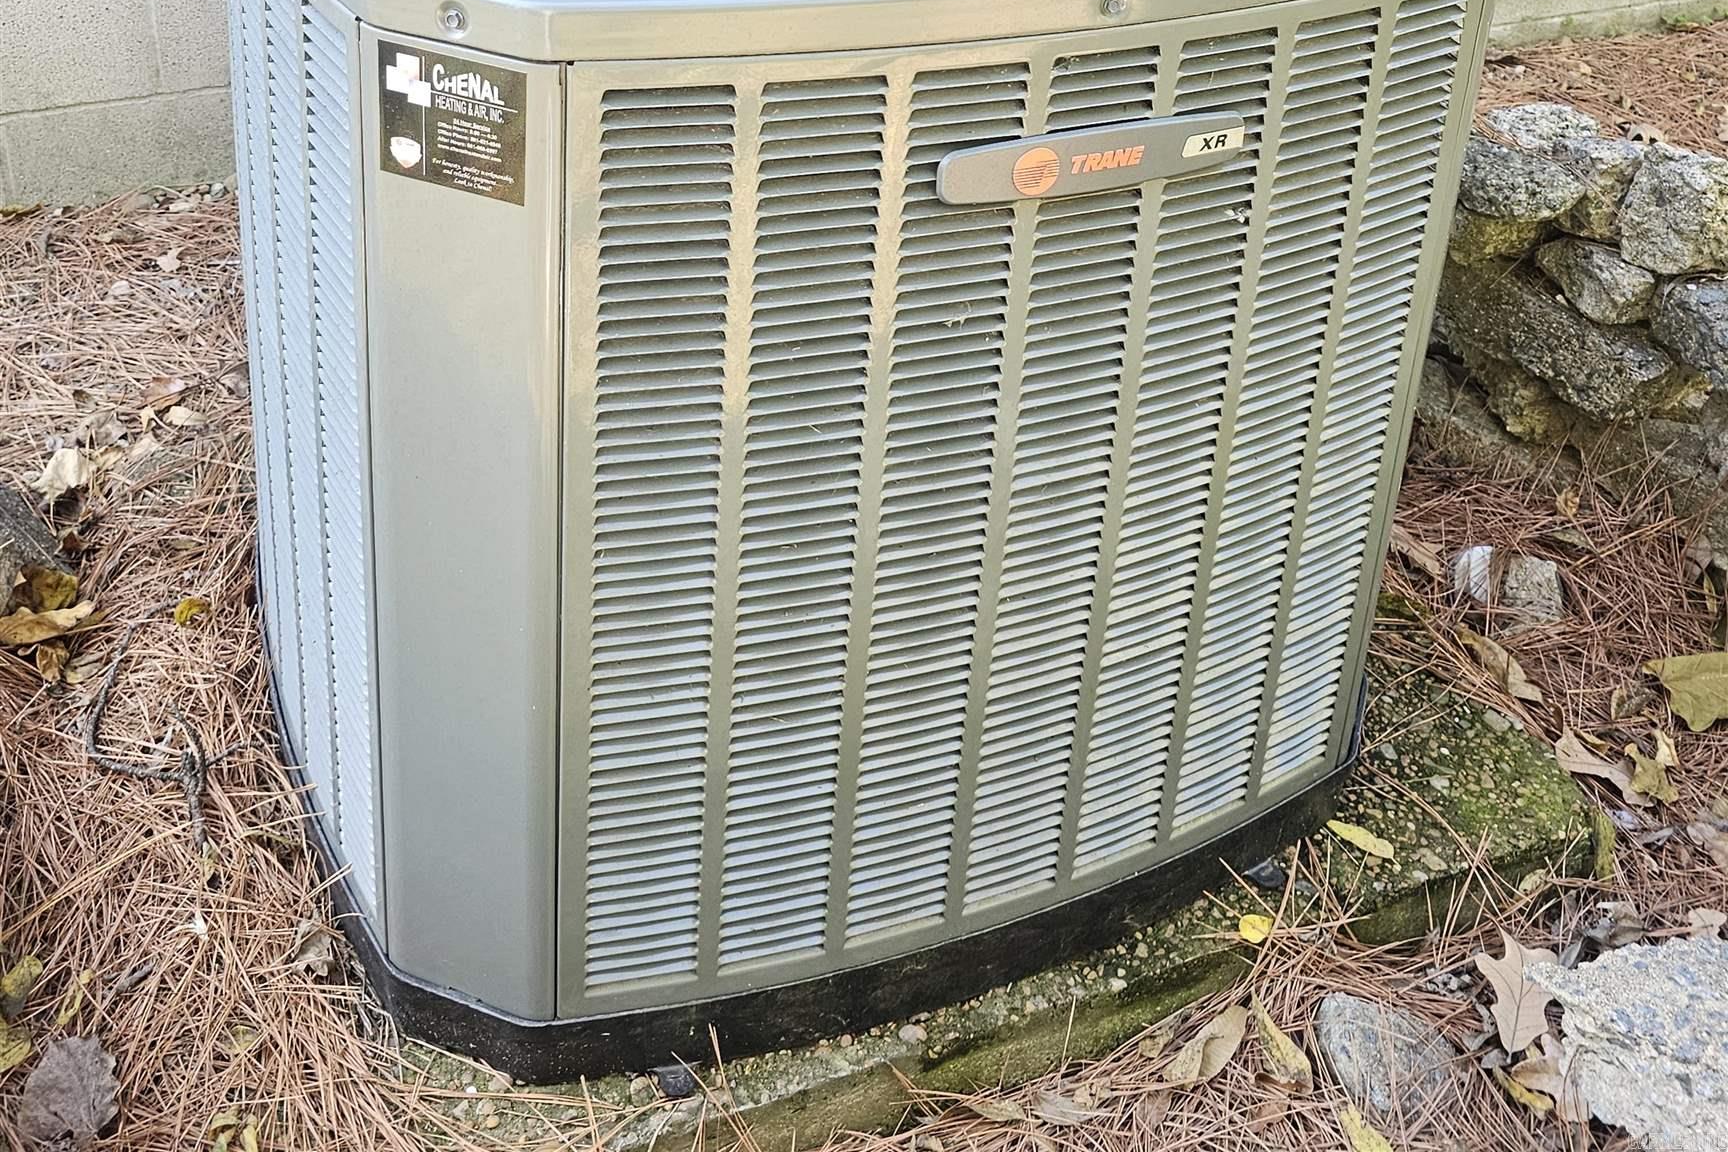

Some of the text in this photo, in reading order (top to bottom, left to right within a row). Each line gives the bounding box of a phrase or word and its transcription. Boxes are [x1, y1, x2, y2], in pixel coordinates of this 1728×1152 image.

[432, 63, 505, 106] CHENAL
[435, 94, 505, 124] HEATING & AIR, INC.
[1200, 133, 1228, 152] XR
[1071, 145, 1145, 175] TRANE
